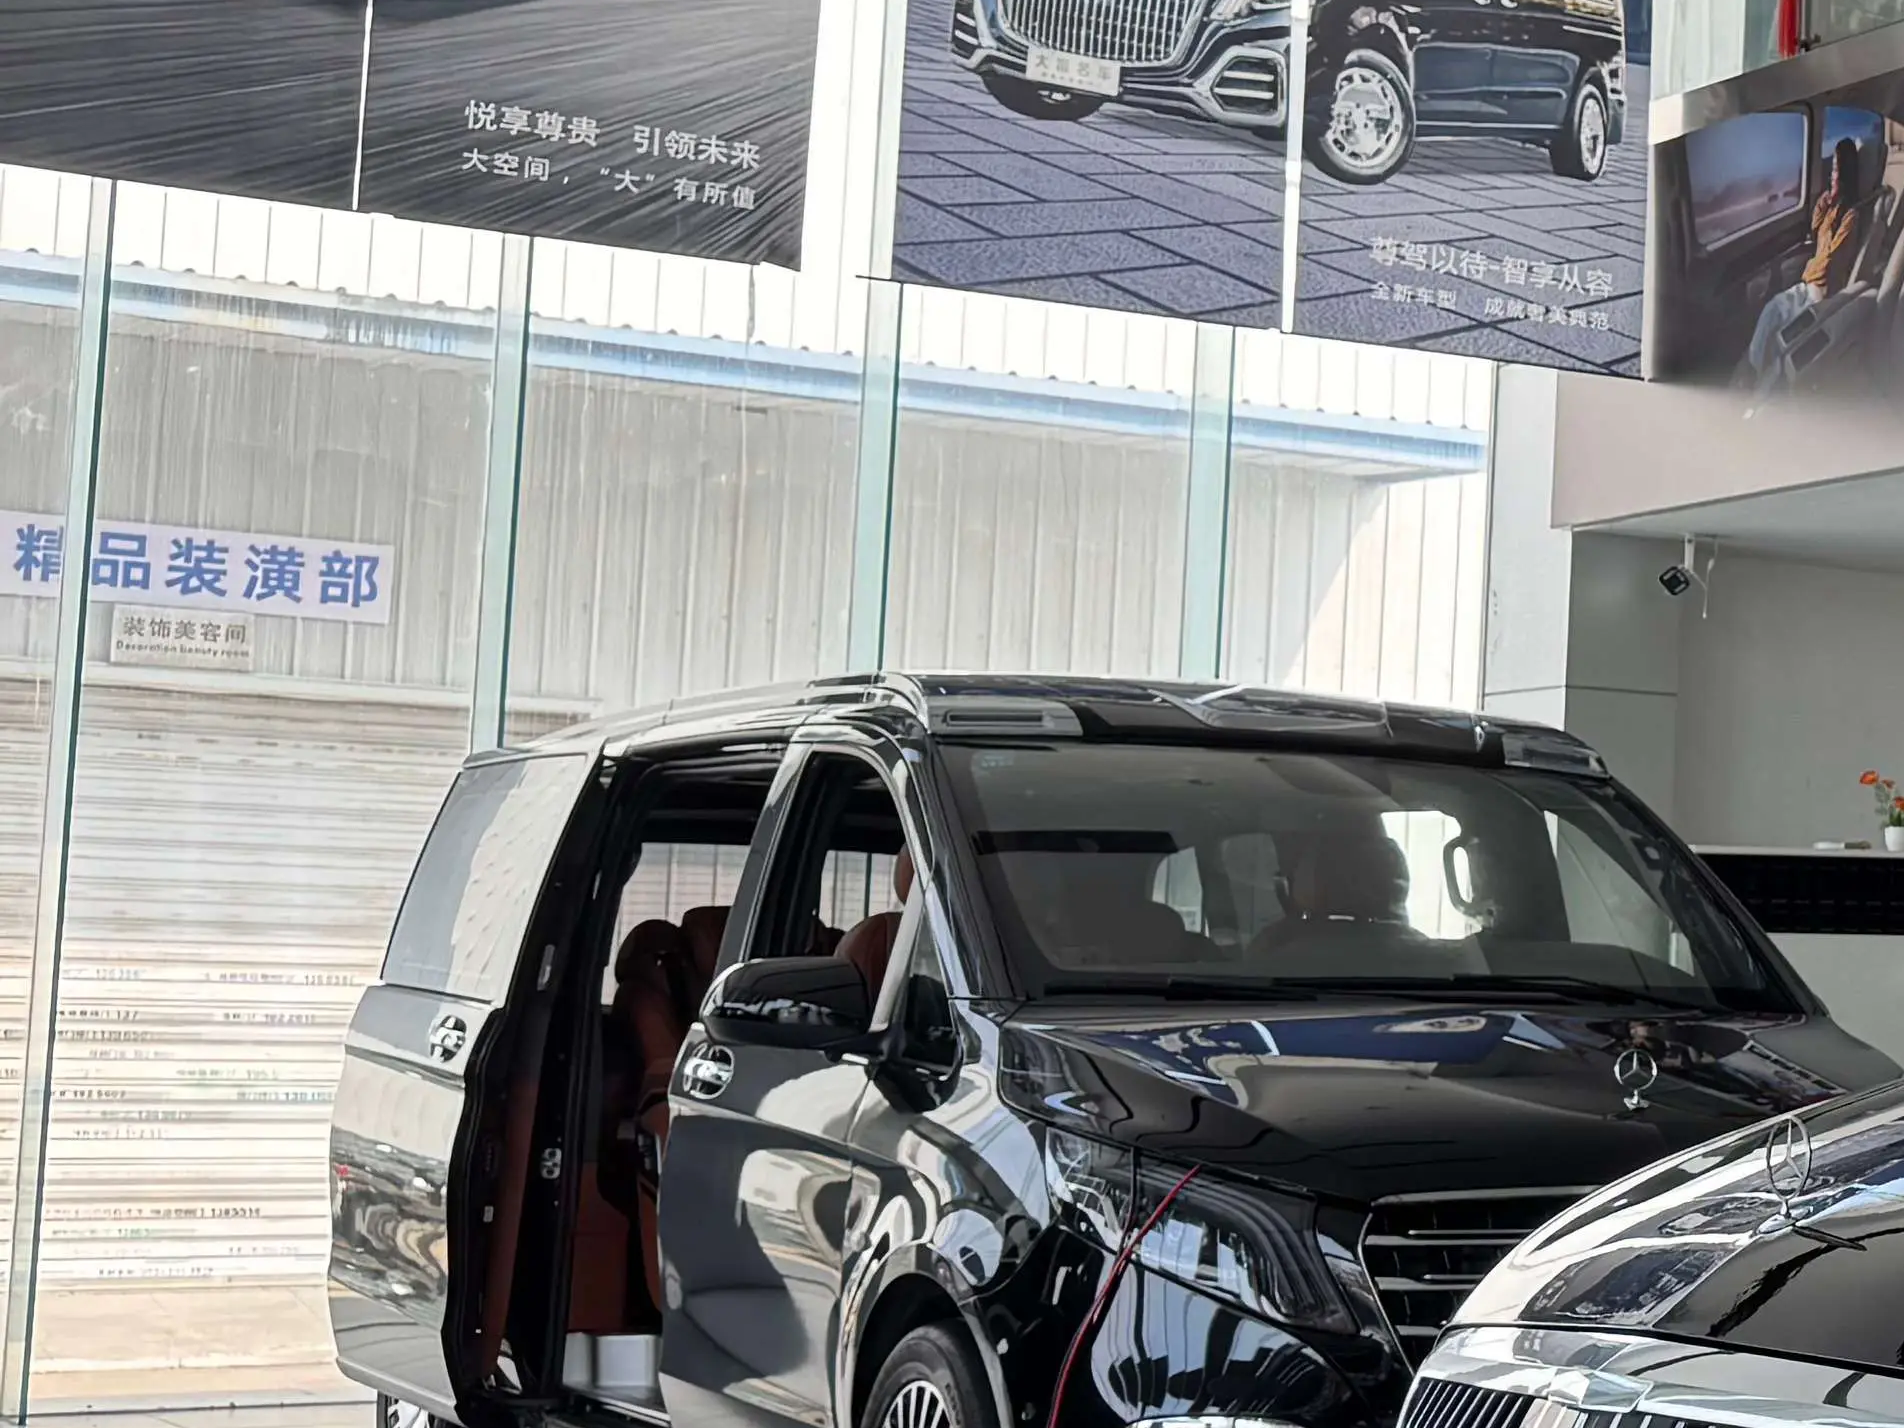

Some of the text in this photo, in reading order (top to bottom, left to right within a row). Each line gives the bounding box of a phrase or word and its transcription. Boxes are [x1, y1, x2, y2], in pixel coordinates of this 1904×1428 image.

[464, 99, 761, 170] 悦享尊贵 引领未来
[1371, 281, 1457, 310] 全新车型
[13, 523, 380, 608] 精品装潢部
[123, 615, 247, 644] 装饰美容间
